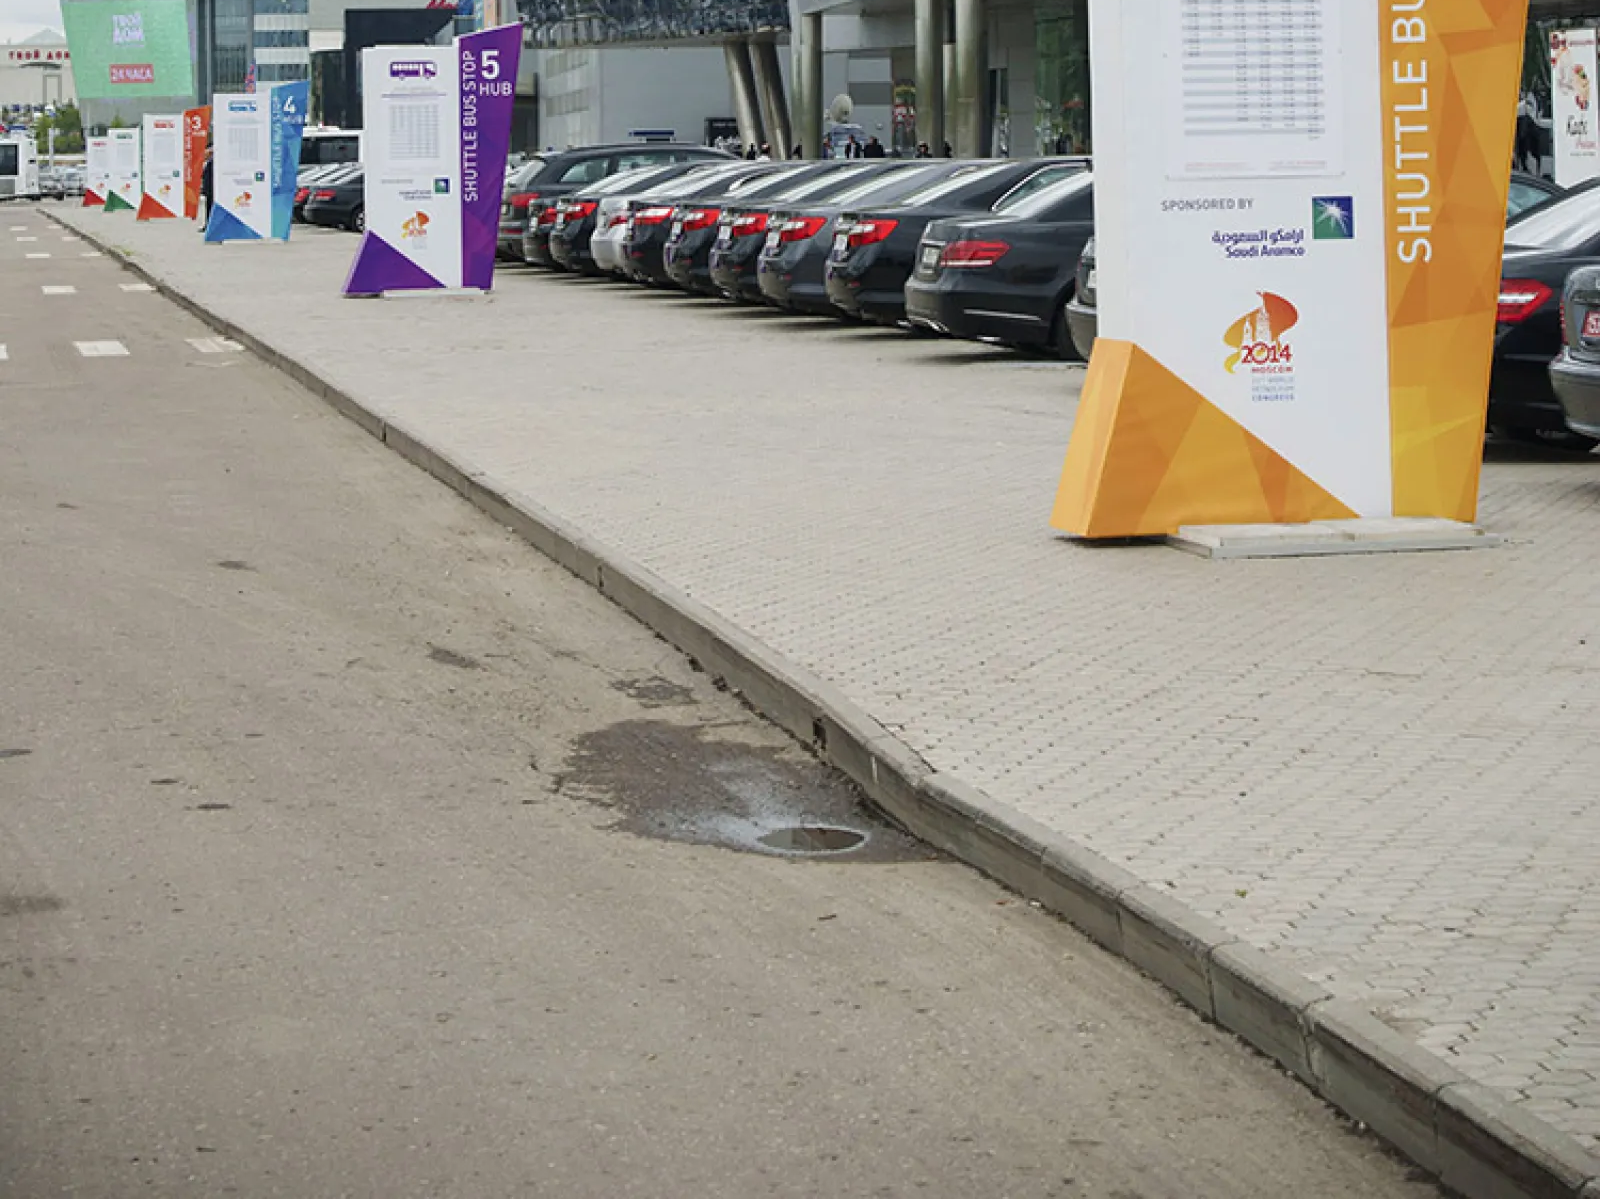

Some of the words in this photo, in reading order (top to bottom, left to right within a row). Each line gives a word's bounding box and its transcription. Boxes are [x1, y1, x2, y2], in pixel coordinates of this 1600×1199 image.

[462, 50, 477, 91] STOP
[481, 49, 500, 80] 5
[479, 81, 513, 96] HUB
[283, 95, 296, 114] 4
[462, 94, 477, 127] BUS
[191, 115, 202, 130] 3
[463, 131, 479, 202] SHUTTLE
[1392, 59, 1433, 264] SHUTTLE
[1160, 198, 1235, 212] SPONSORED
[1237, 198, 1255, 210] BY
[1225, 244, 1260, 258] Saudi
[1260, 244, 1305, 257] Aramco
[1241, 341, 1293, 365] 2014
